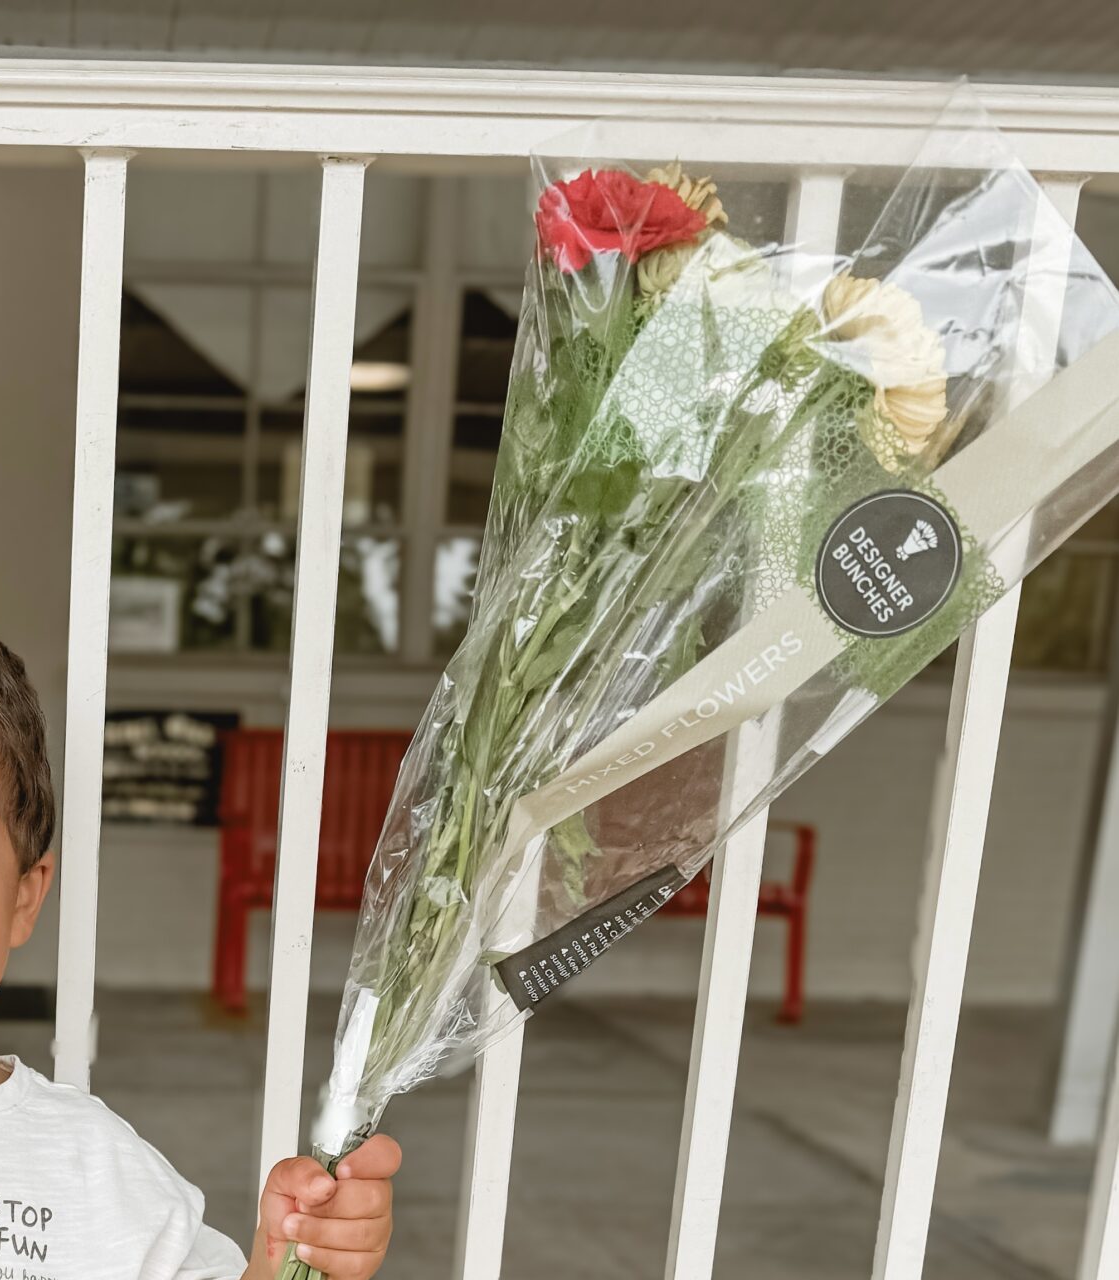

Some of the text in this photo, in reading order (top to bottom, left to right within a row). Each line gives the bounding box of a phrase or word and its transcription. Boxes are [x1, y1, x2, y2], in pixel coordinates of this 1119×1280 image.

[831, 542, 895, 625] BUNCHES
[847, 526, 915, 613] DESIGNER
[565, 630, 803, 795] MIXED FLOWERS
